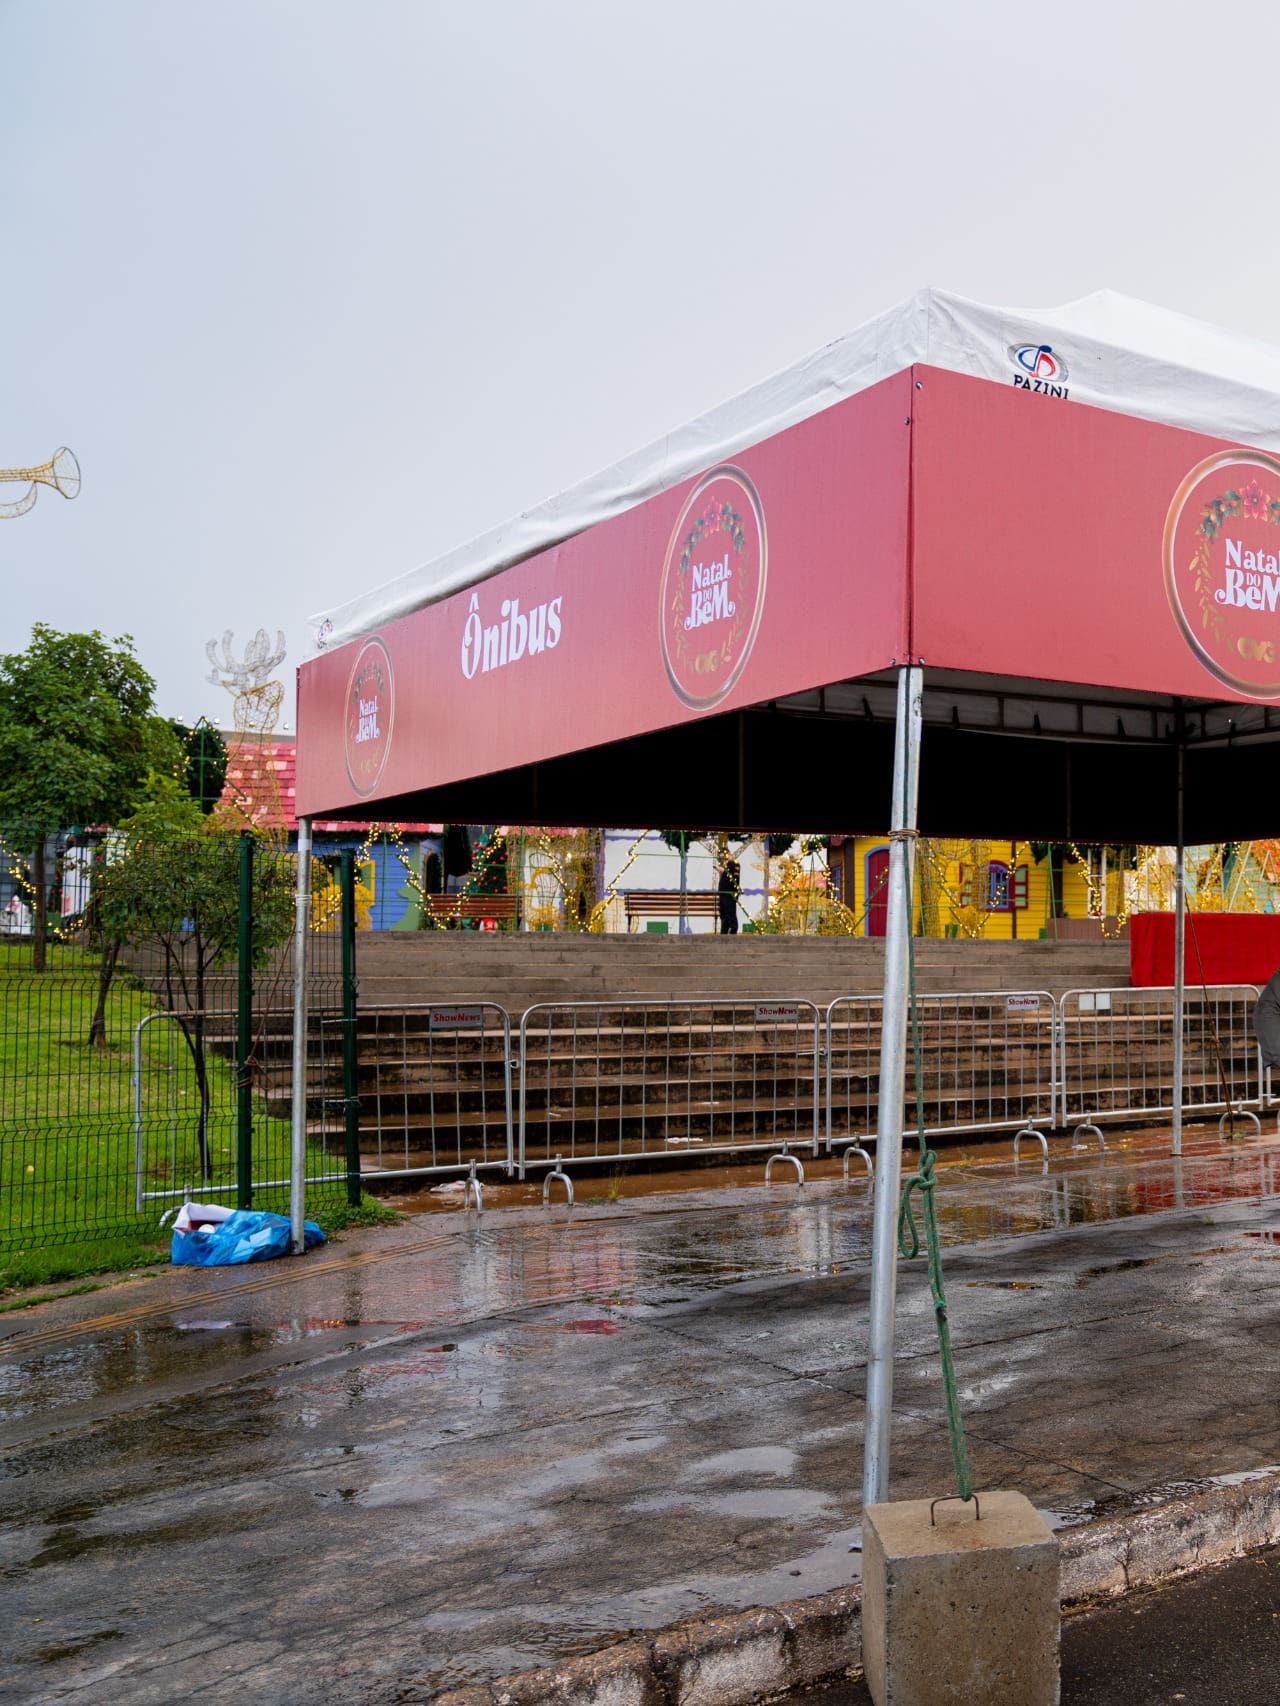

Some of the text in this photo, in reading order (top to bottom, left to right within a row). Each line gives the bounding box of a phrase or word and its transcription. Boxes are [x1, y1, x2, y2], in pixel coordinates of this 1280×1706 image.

[1013, 374, 1069, 400] PAZINI
[691, 554, 732, 592] Natal
[1246, 572, 1261, 587] DO
[461, 591, 563, 680] Ônibus
[433, 1012, 481, 1022] ShowNews
[759, 1007, 797, 1015] ShowNews
